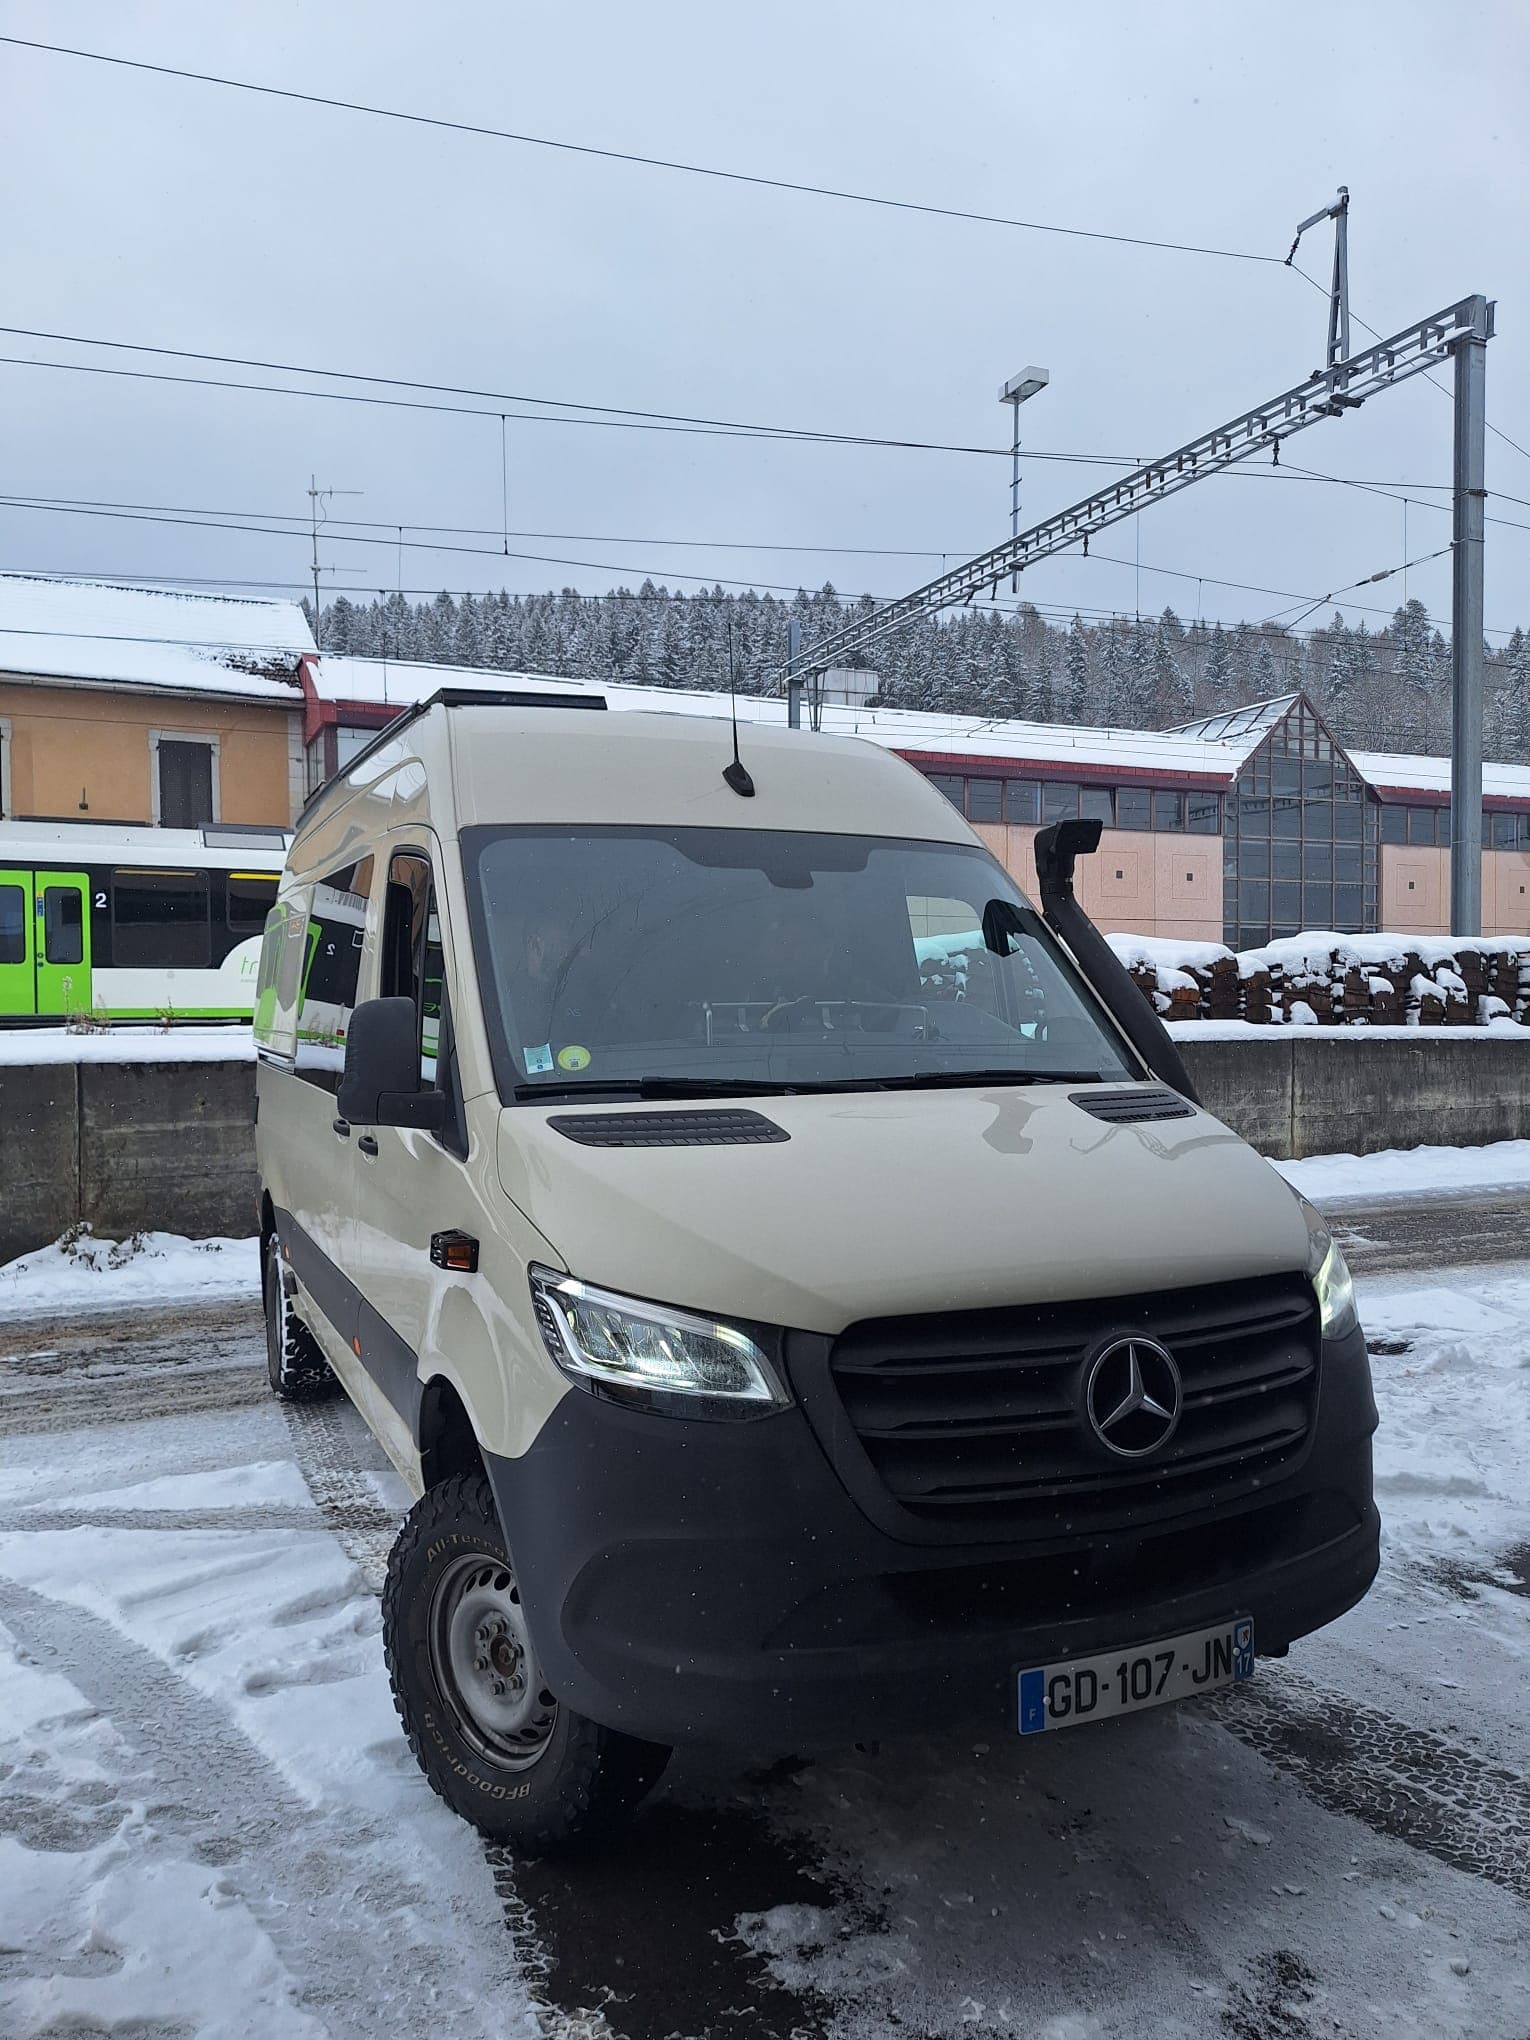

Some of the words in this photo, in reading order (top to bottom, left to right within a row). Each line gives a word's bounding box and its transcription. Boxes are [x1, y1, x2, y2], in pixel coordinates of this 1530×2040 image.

[95, 892, 107, 908] 2
[1236, 1651, 1251, 1675] 17
[1049, 1634, 1233, 1719] GD-107-JN
[1028, 1707, 1037, 1722] F
